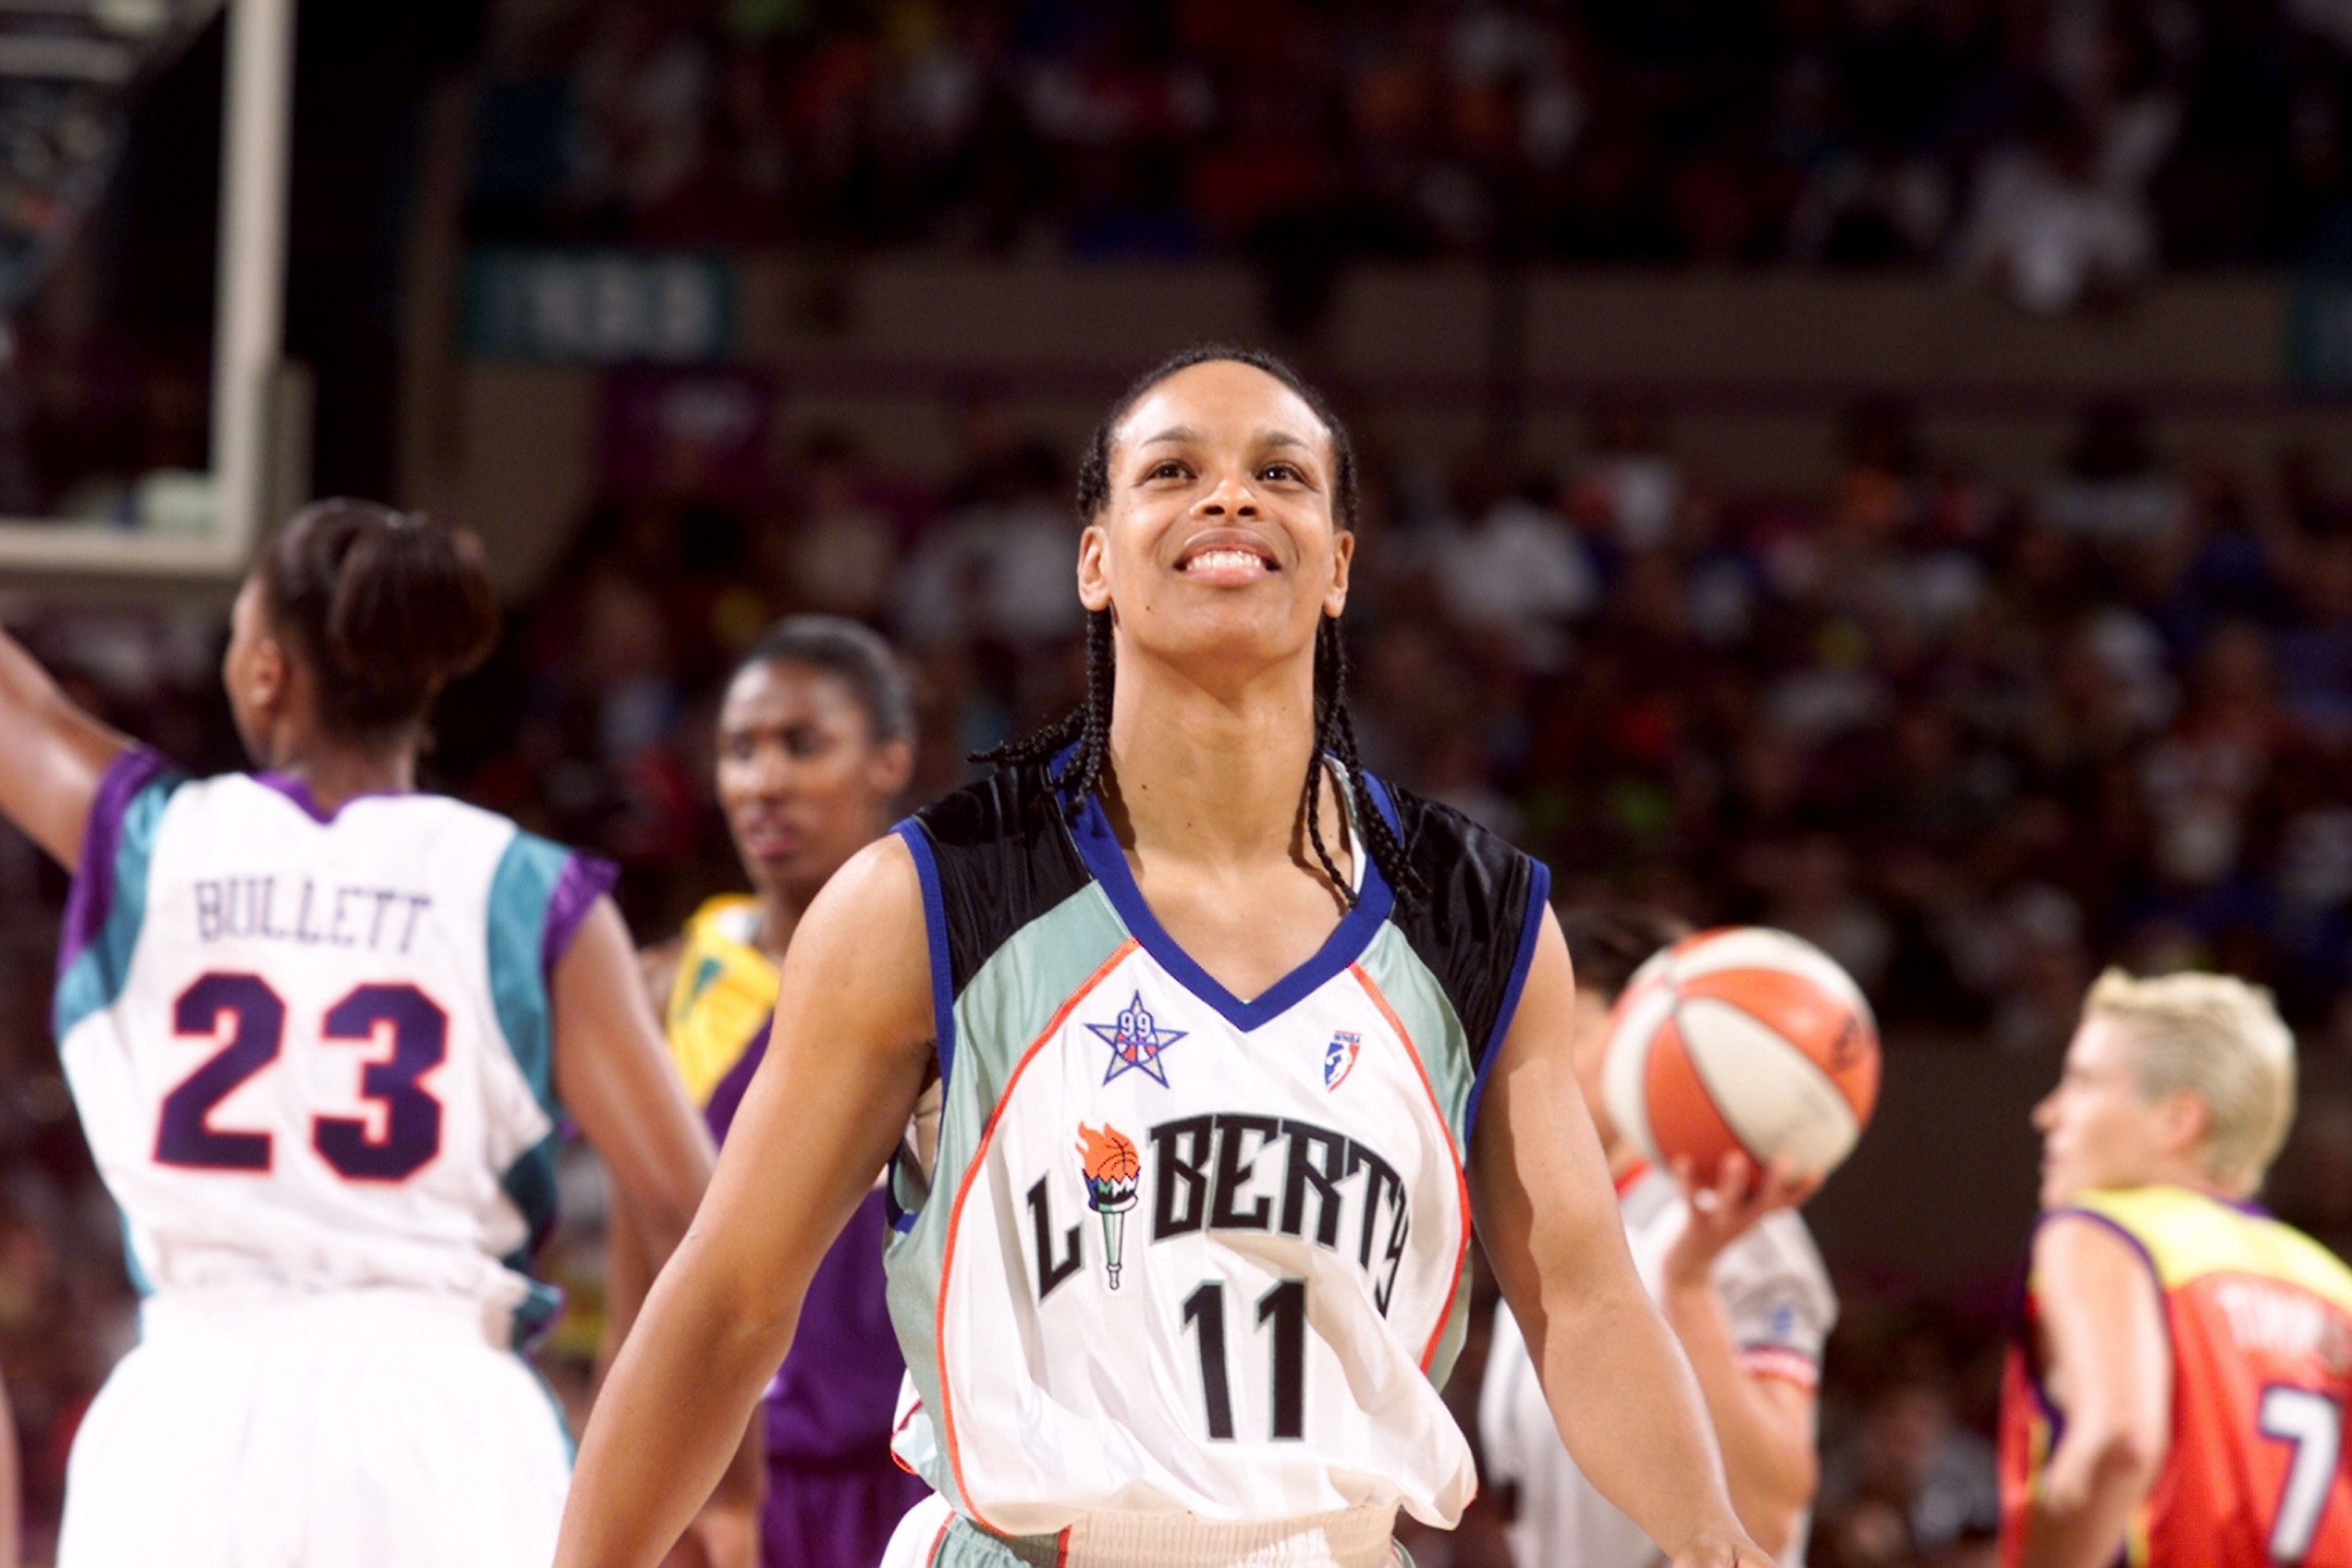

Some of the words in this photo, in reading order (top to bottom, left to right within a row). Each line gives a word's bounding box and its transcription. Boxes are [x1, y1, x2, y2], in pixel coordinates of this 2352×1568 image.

[194, 877, 433, 954] BULLETT
[152, 971, 449, 1185] 23
[1120, 1010, 1152, 1037] 99
[1179, 1277, 1308, 1442] 11
[2258, 1381, 2343, 1564] 7
